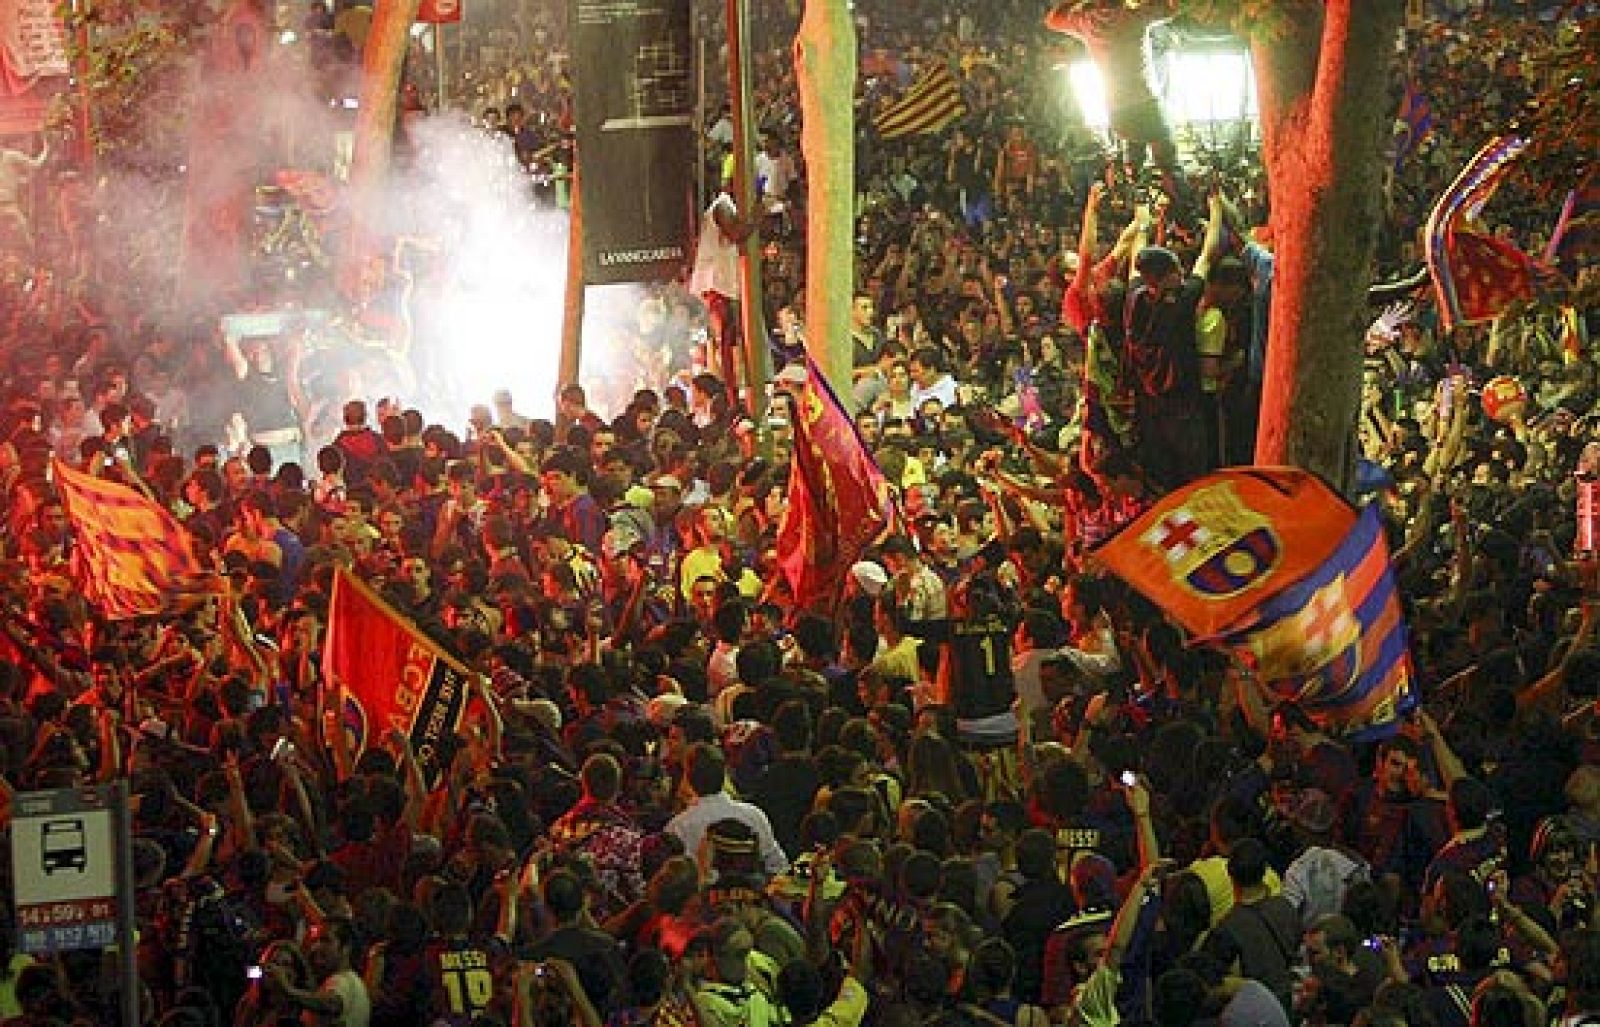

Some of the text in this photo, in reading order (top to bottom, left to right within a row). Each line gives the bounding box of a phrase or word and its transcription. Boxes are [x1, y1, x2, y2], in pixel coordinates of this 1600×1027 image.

[980, 636, 996, 676] 1
[1056, 828, 1099, 848] MESSI
[439, 949, 487, 970] MESSI
[441, 971, 493, 1014] 10
